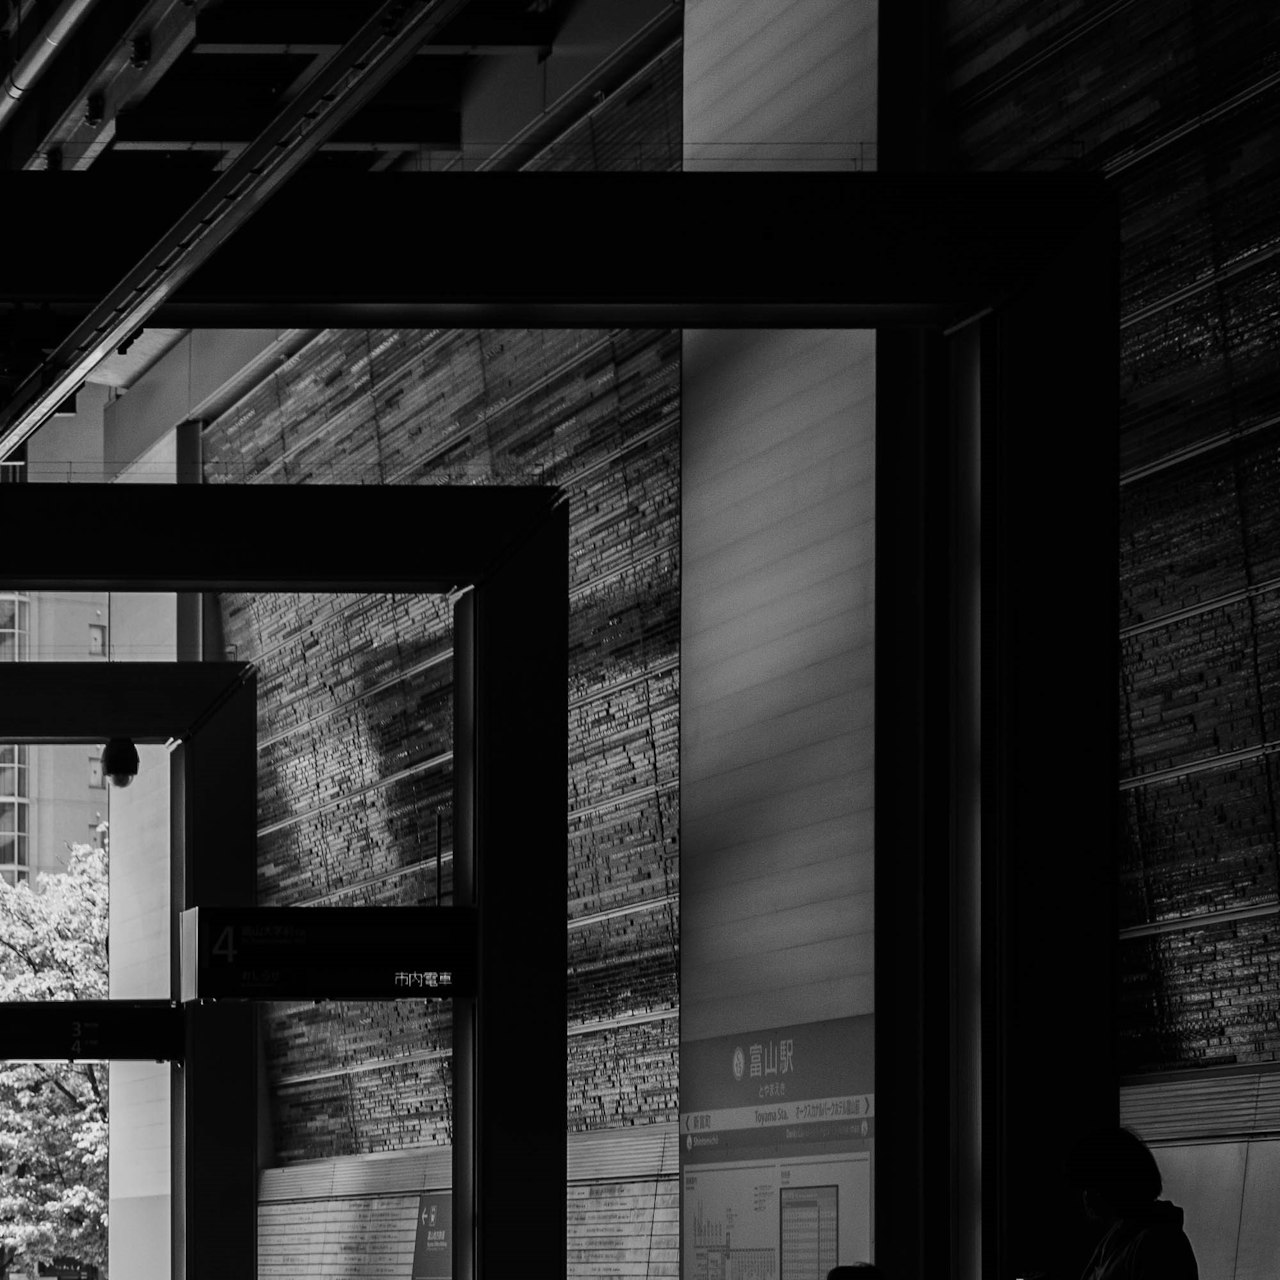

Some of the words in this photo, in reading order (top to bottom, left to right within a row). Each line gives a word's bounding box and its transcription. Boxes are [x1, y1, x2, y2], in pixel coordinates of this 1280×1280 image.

[212, 925, 238, 963] 4
[394, 971, 453, 987] 市内電車
[72, 1021, 82, 1037] 3
[71, 1040, 82, 1054] 4
[749, 1039, 794, 1078] 富山駅
[758, 1082, 786, 1098] とやまえき
[755, 1110, 777, 1125] Toyama
[778, 1107, 790, 1121] Sta.
